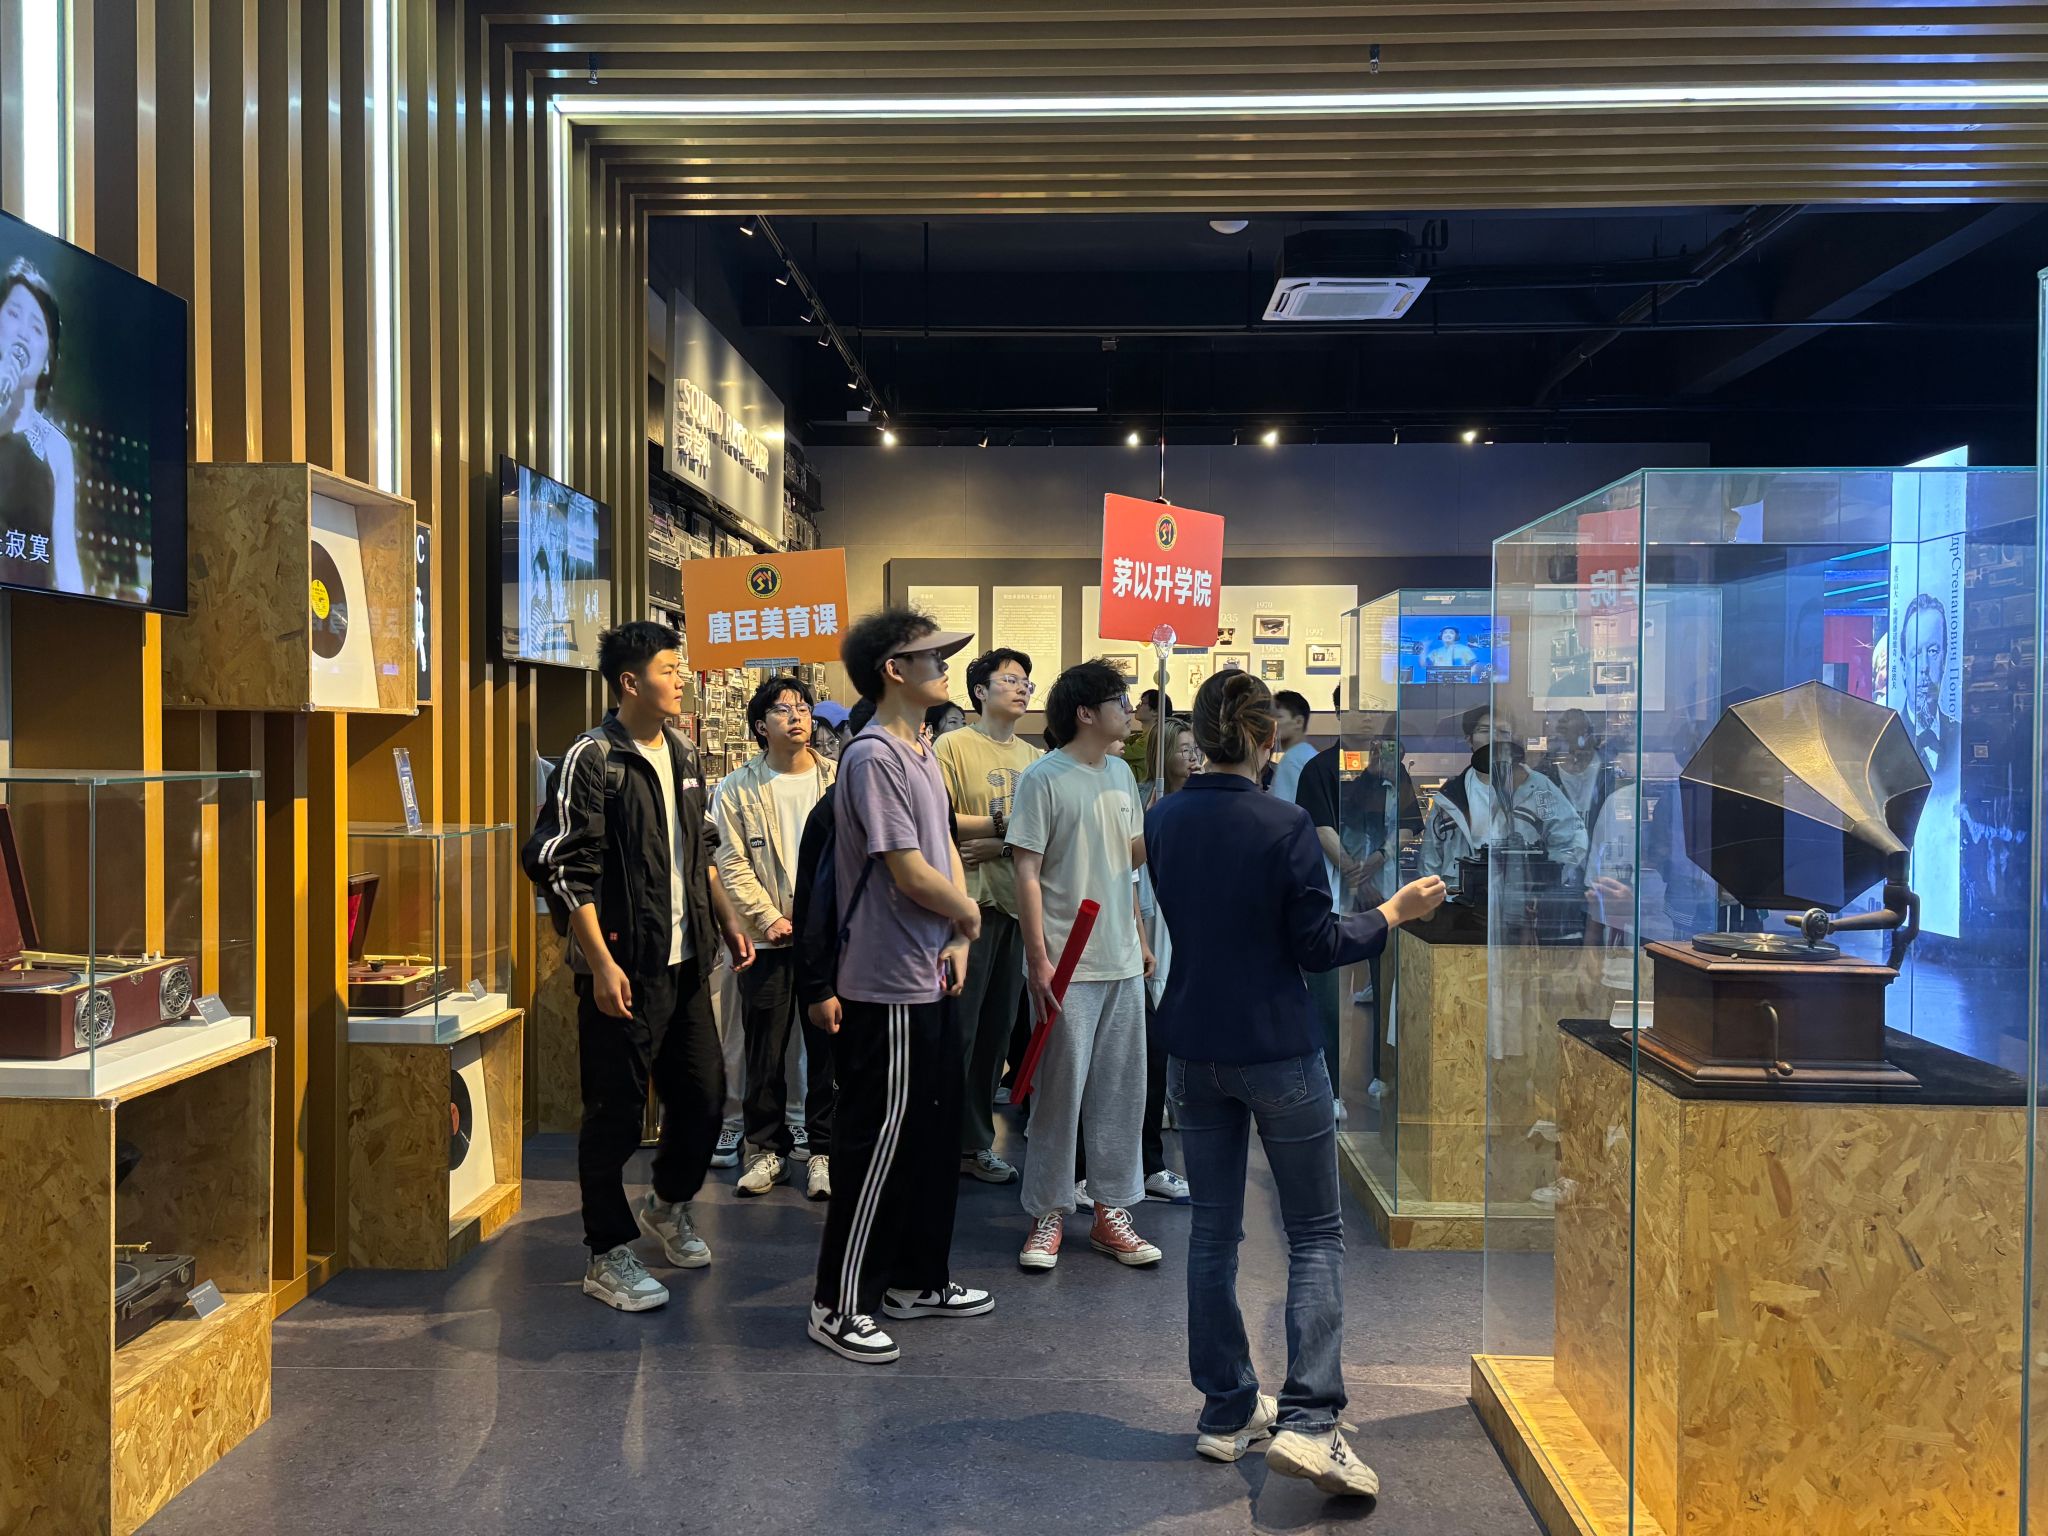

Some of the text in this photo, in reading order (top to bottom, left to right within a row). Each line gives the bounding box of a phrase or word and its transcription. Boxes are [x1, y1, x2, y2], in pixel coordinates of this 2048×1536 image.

[678, 379, 722, 436] SOUND
[0, 529, 50, 564] 寂寞
[1112, 556, 1213, 608] 茅以升学院
[708, 603, 838, 644] 唐臣美育课
